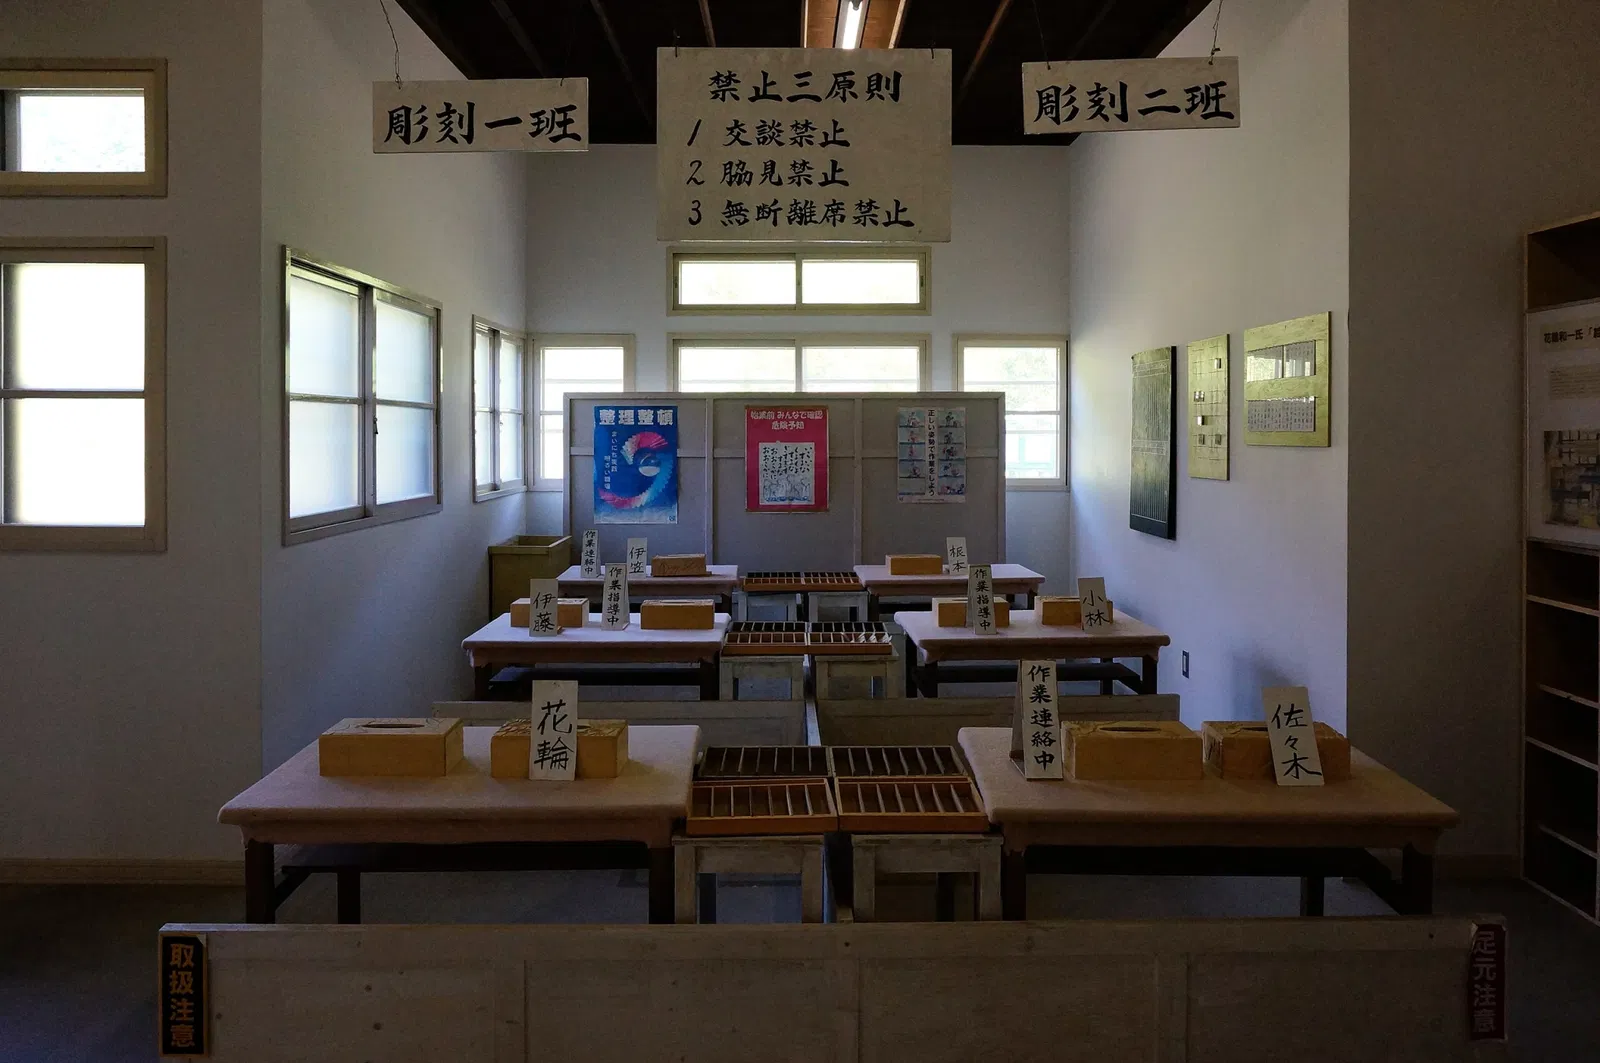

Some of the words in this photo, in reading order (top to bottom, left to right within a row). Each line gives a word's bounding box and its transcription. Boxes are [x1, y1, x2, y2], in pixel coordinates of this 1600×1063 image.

[708, 69, 902, 104] 禁止三原則
[1033, 80, 1235, 126] 彫刻二班
[383, 101, 583, 145] 彫刻一班
[687, 119, 702, 148] 1
[722, 118, 851, 148] 交談禁止
[686, 159, 706, 187] 2
[720, 159, 850, 188] 脇見禁止
[688, 199, 702, 226] 3
[720, 197, 915, 228] 無断離席禁止
[599, 409, 674, 426] 整理整頓
[584, 530, 596, 575] 作業連絡中
[949, 546, 967, 572] 根本
[532, 591, 556, 633] 伊藤
[606, 566, 623, 627] 作業指導中
[974, 568, 992, 631] 作業指導中
[1082, 589, 1110, 627] 小林
[533, 699, 574, 771] 花輪
[1026, 664, 1057, 771] 作業連絡中
[1270, 703, 1322, 779] 佐々木
[168, 942, 196, 1049] 取扱注意
[1472, 930, 1497, 1033] 足元注意
